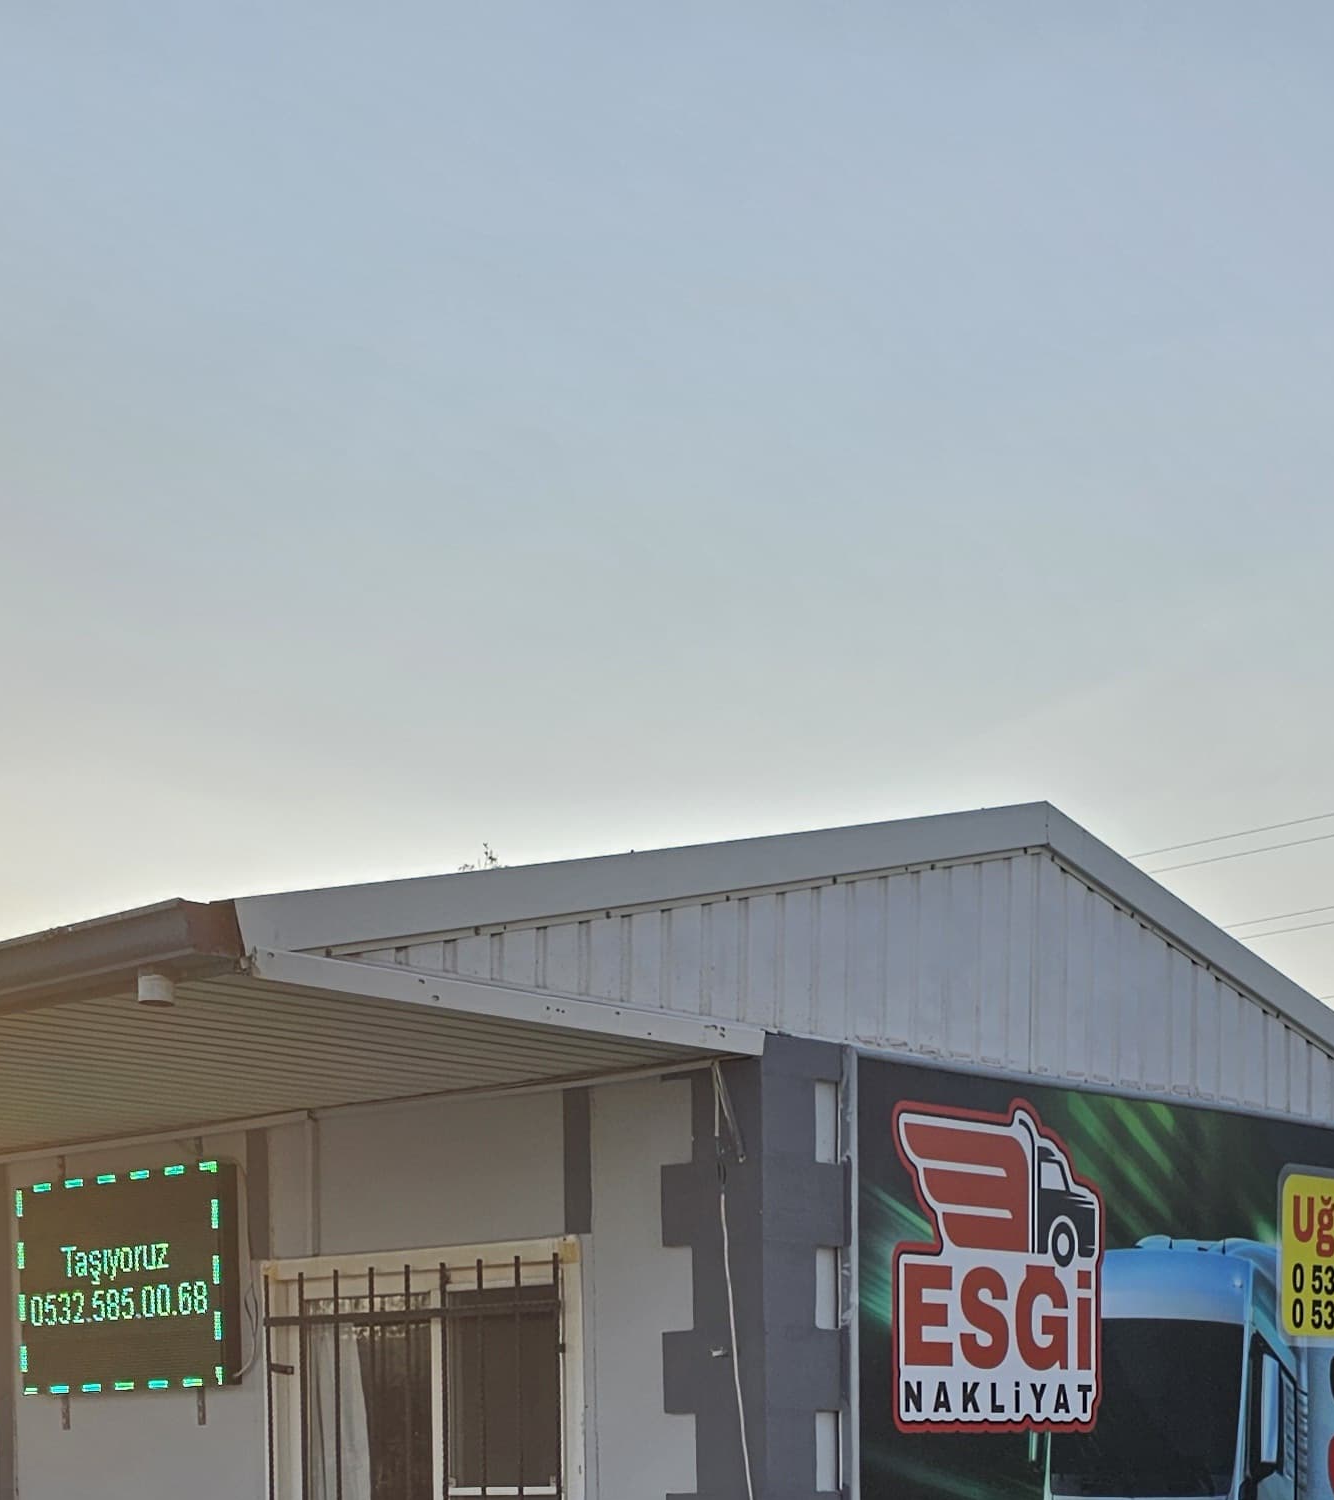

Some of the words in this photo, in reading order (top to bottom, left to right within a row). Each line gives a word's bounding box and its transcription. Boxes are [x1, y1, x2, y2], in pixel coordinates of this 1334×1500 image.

[60, 1243, 170, 1286] Taşıyoruz
[1292, 1263, 1304, 1294] 0
[29, 1281, 208, 1327] 0532.585.00.68
[1292, 1298, 1304, 1329] 0
